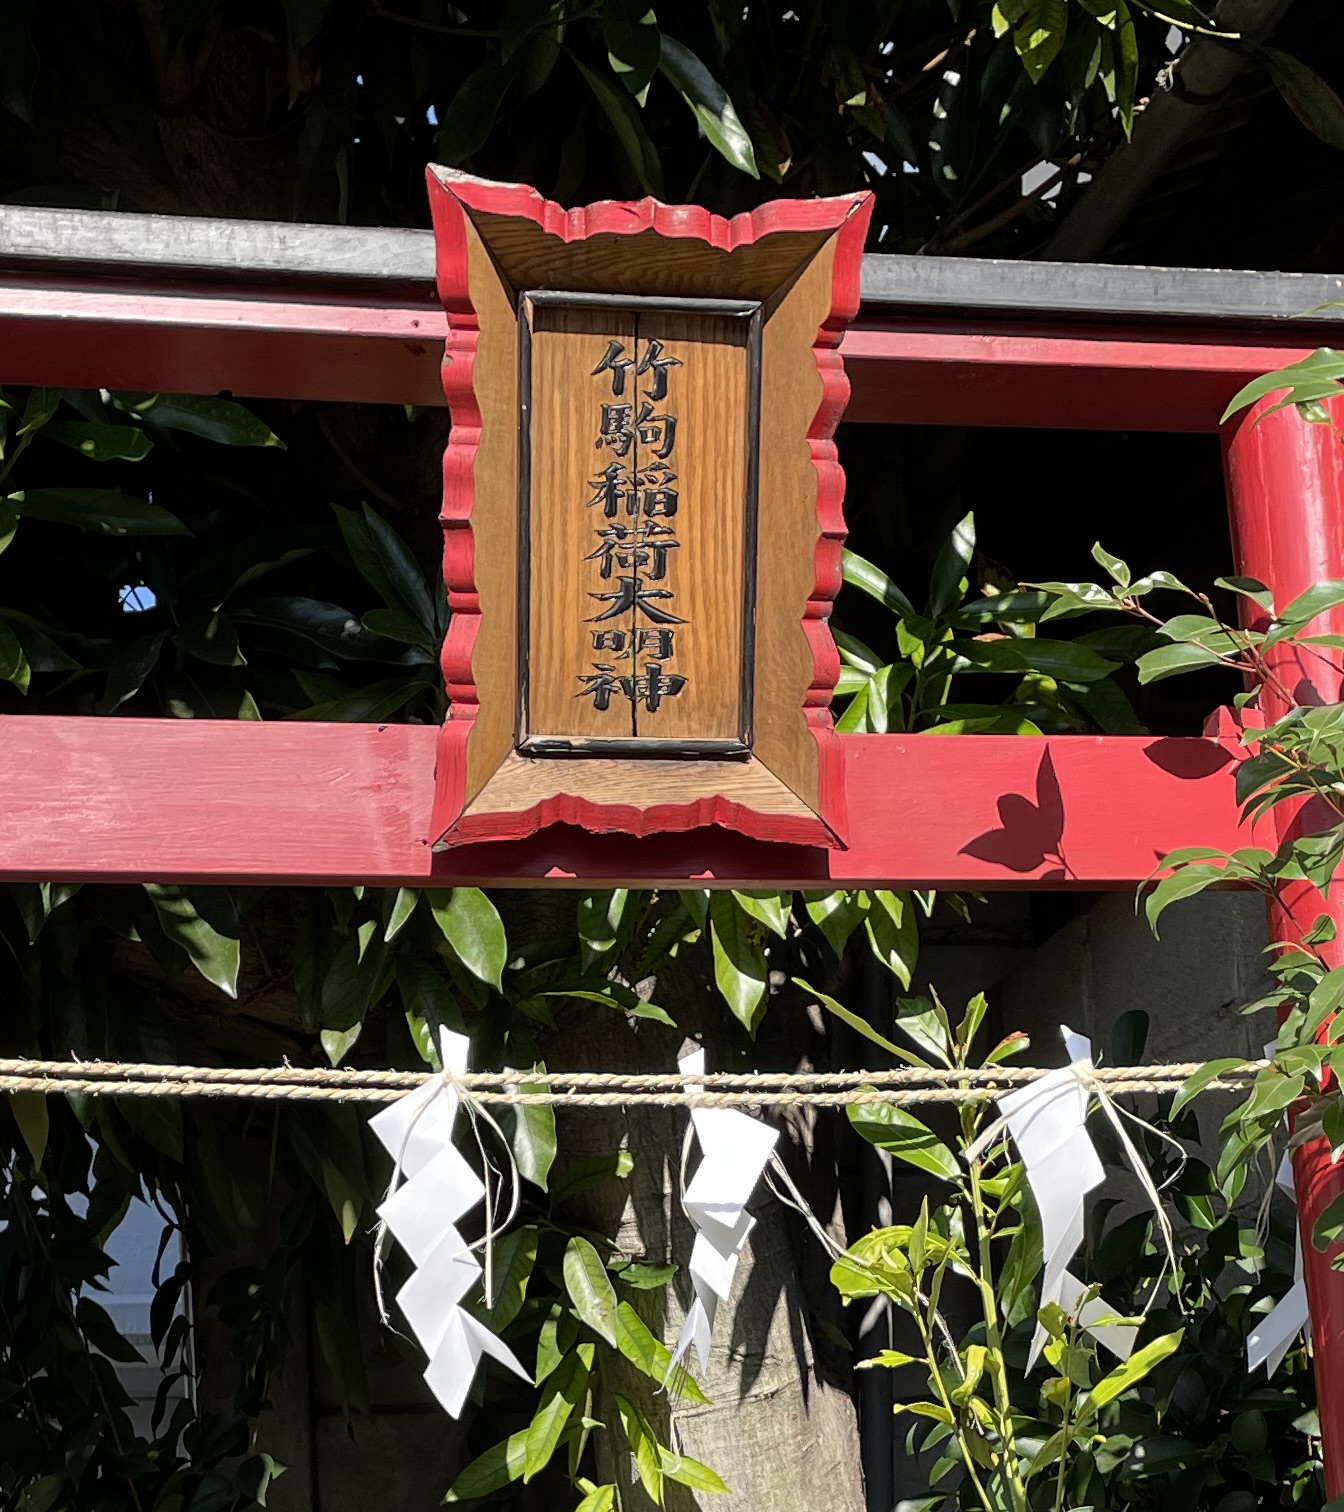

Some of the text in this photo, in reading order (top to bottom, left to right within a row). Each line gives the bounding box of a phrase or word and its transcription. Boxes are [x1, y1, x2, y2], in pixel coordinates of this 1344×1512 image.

[575, 338, 691, 713] 竹駒稲荷大明神
